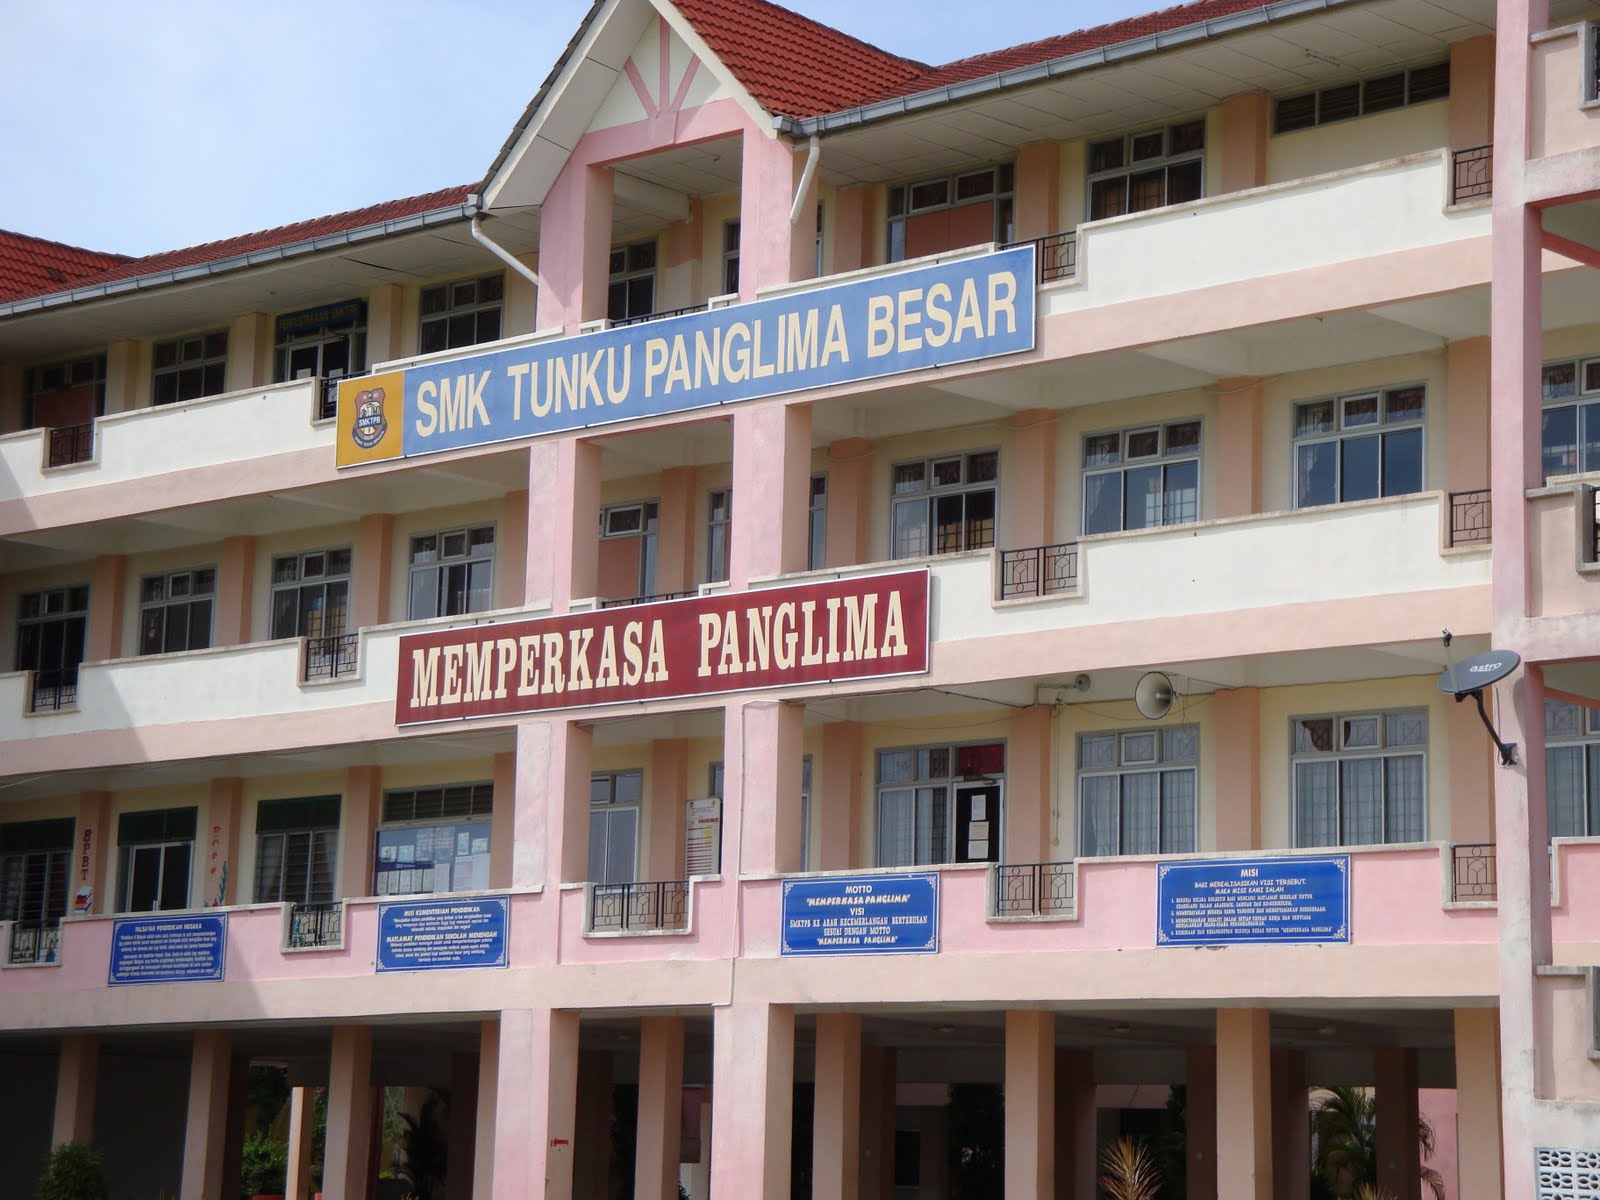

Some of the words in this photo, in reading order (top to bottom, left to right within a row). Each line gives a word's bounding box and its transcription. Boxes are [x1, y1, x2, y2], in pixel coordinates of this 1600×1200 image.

[414, 370, 490, 438] SMK
[507, 345, 632, 424] TUNKU
[645, 303, 850, 398] PANGLIMA
[867, 270, 1018, 358] BESAR
[358, 416, 381, 427] SMKTPB
[410, 618, 669, 708] MEMPERKASA
[698, 590, 909, 678] PANGLIMA
[1470, 662, 1502, 672] astro
[1240, 868, 1258, 878] MISI
[1209, 880, 1258, 888] MEREALISASIKAN
[845, 885, 872, 894] MOTTO
[850, 907, 864, 916] VISI
[790, 919, 811, 928] SMKTPB
[812, 919, 820, 927] KE
[823, 918, 838, 927] ARAH
[840, 917, 888, 926] KECEMERLANGAN
[892, 916, 928, 925] BERTERUSAN
[824, 928, 842, 936] SESUAI
[844, 927, 867, 935] DENGAN
[870, 926, 890, 935] MOTTO
